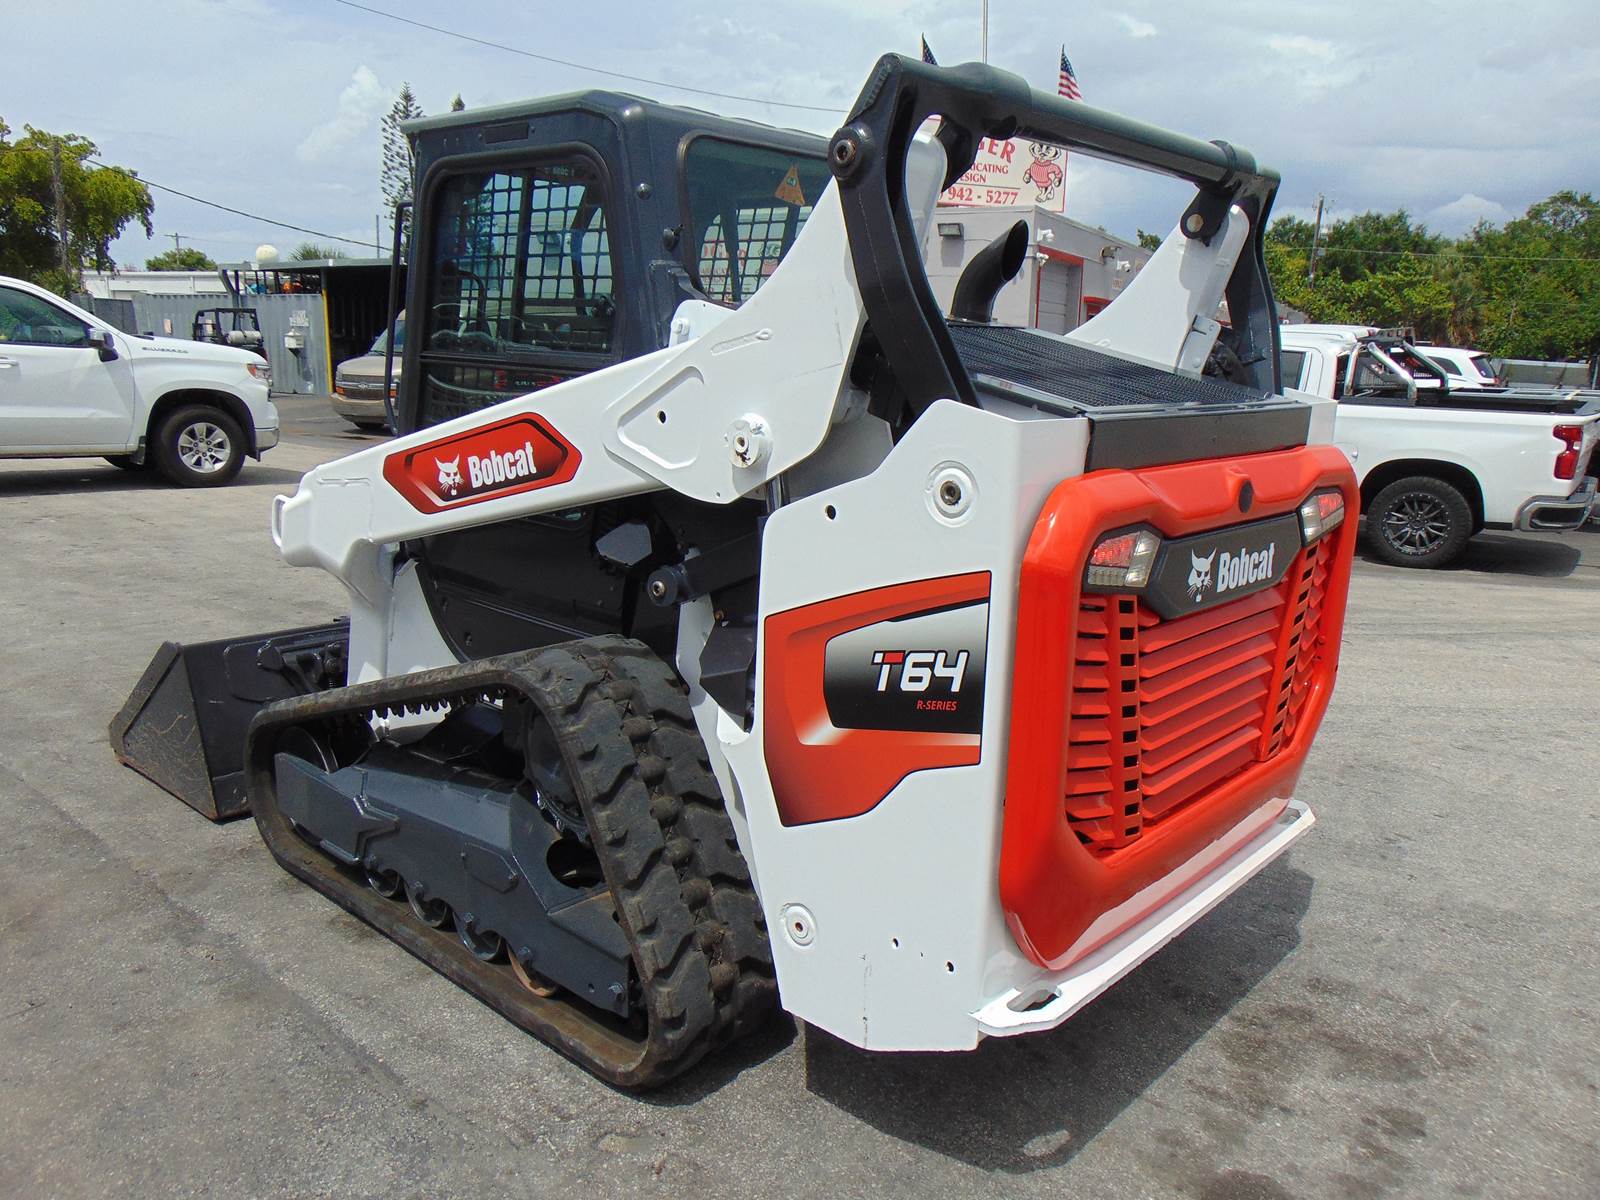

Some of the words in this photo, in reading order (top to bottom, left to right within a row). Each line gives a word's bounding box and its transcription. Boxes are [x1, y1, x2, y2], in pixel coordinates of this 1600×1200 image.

[971, 163, 1009, 174] ICATING
[948, 186, 973, 201] 942
[986, 189, 1019, 205] 5277
[467, 442, 536, 488] Bobcat
[1217, 543, 1274, 592] Bobcat
[871, 650, 970, 693] T64
[916, 700, 957, 711] R-SERIES
